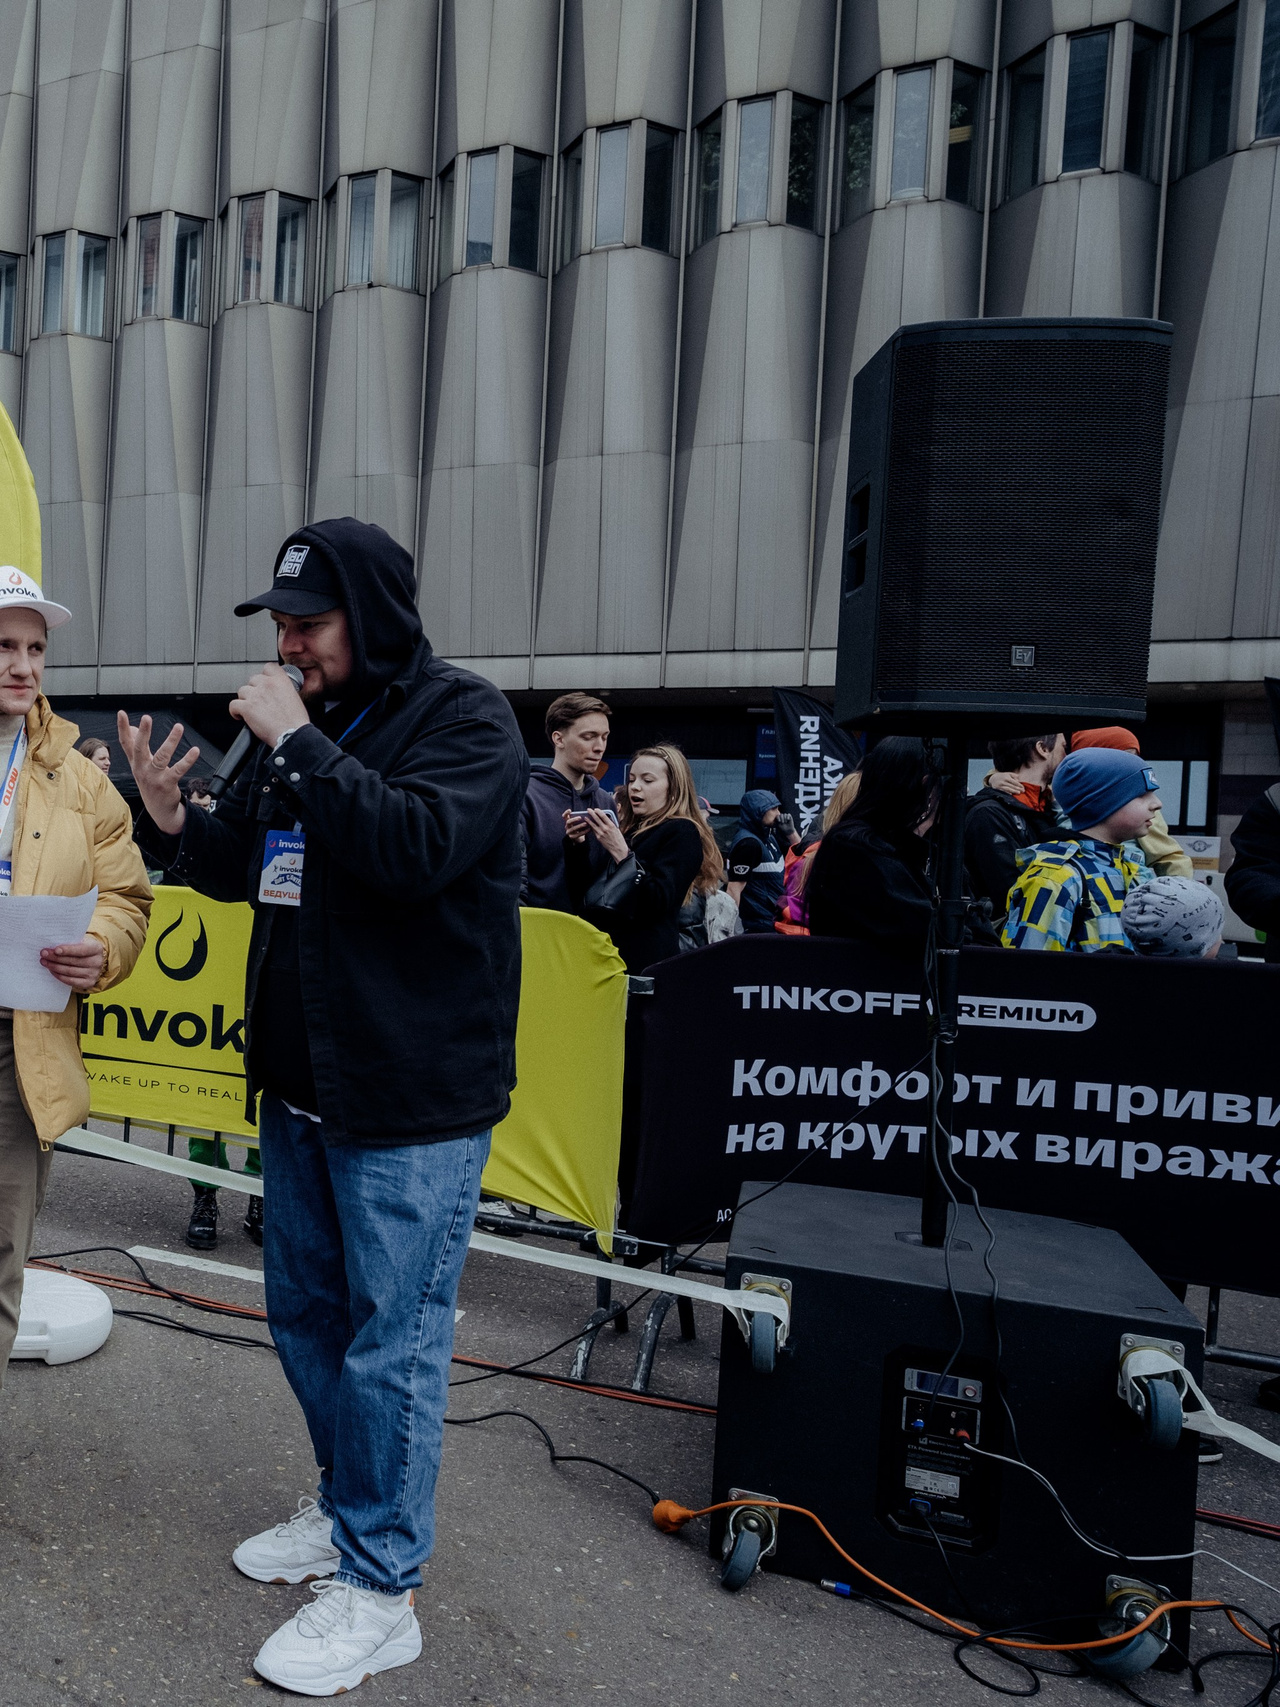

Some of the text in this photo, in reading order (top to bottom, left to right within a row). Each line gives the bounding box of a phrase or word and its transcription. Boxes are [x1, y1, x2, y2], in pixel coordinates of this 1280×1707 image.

[3, 768, 19, 806] MOTO
[278, 839, 306, 850] invok
[733, 985, 1084, 1025] TINKOFF REMIUM
[80, 999, 246, 1054] invok
[138, 1078, 160, 1089] UP
[167, 1082, 190, 1094] TO
[197, 1086, 243, 1102] REAL
[1016, 1077, 1057, 1109] и
[725, 1121, 786, 1154] на
[1035, 1132, 1280, 1185] вираж
